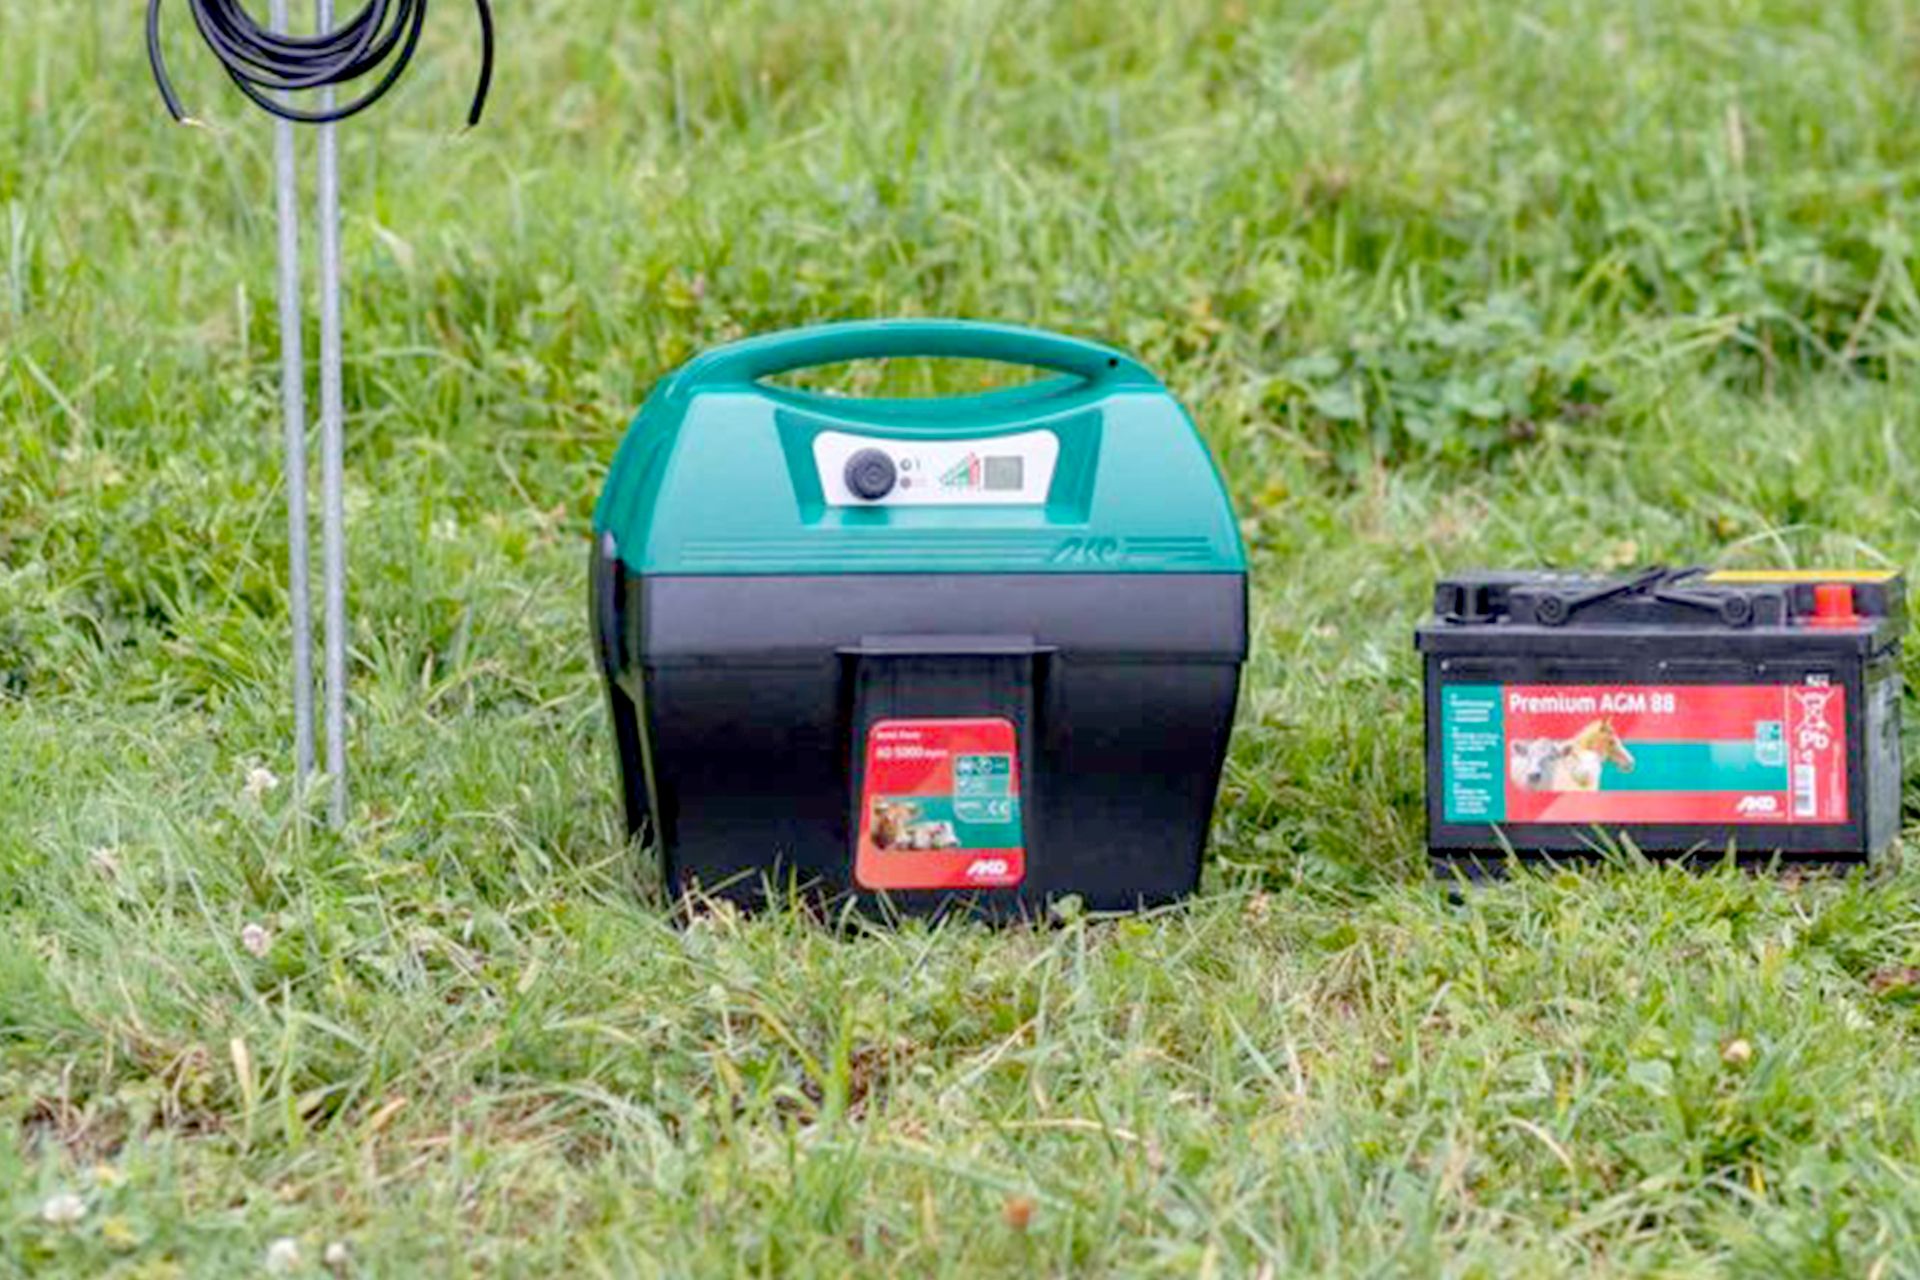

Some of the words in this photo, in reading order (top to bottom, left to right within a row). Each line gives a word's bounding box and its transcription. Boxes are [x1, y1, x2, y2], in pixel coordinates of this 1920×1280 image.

[1509, 693, 1595, 713] Premium
[1600, 694, 1645, 713] AGM
[1651, 693, 1675, 714] 88
[1799, 730, 1829, 750] Pb
[966, 859, 1008, 876] AKO
